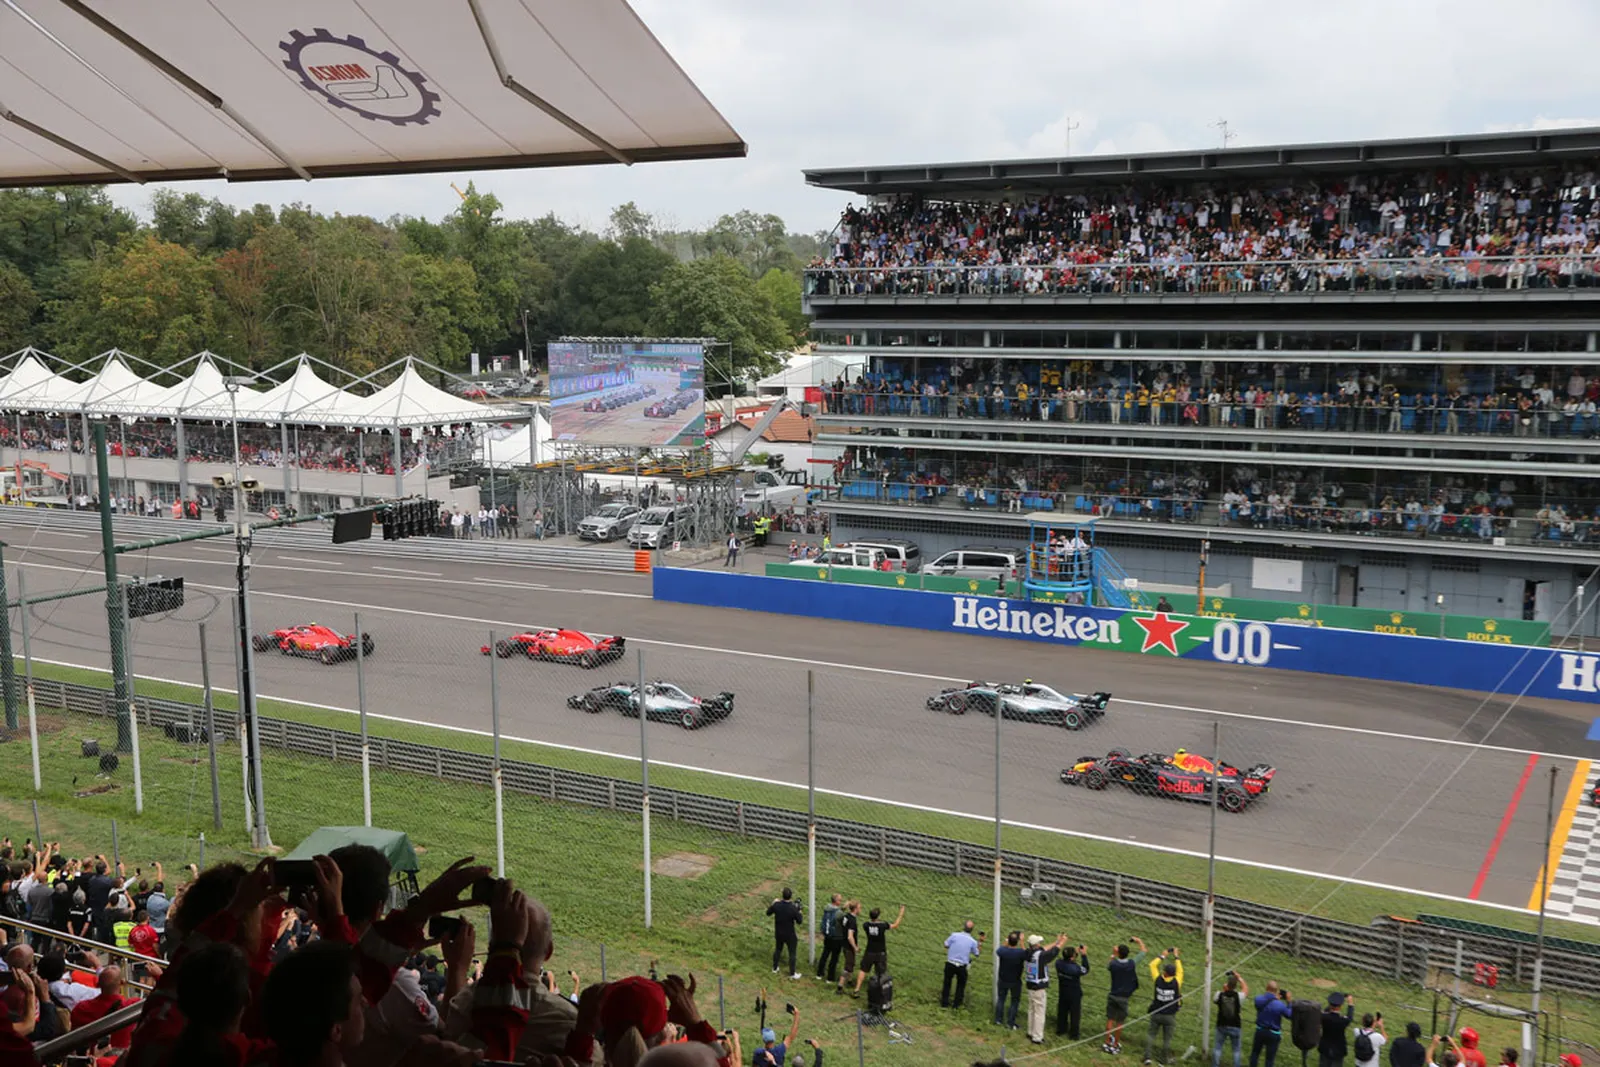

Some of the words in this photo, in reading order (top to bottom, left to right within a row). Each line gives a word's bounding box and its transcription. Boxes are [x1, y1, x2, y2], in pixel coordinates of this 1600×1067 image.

[952, 596, 1122, 644] Heineken
[1374, 624, 1417, 636] ROLEX
[1466, 632, 1512, 644] ROLEX
[1211, 621, 1271, 665] 0.0
[1557, 653, 1600, 692] H
